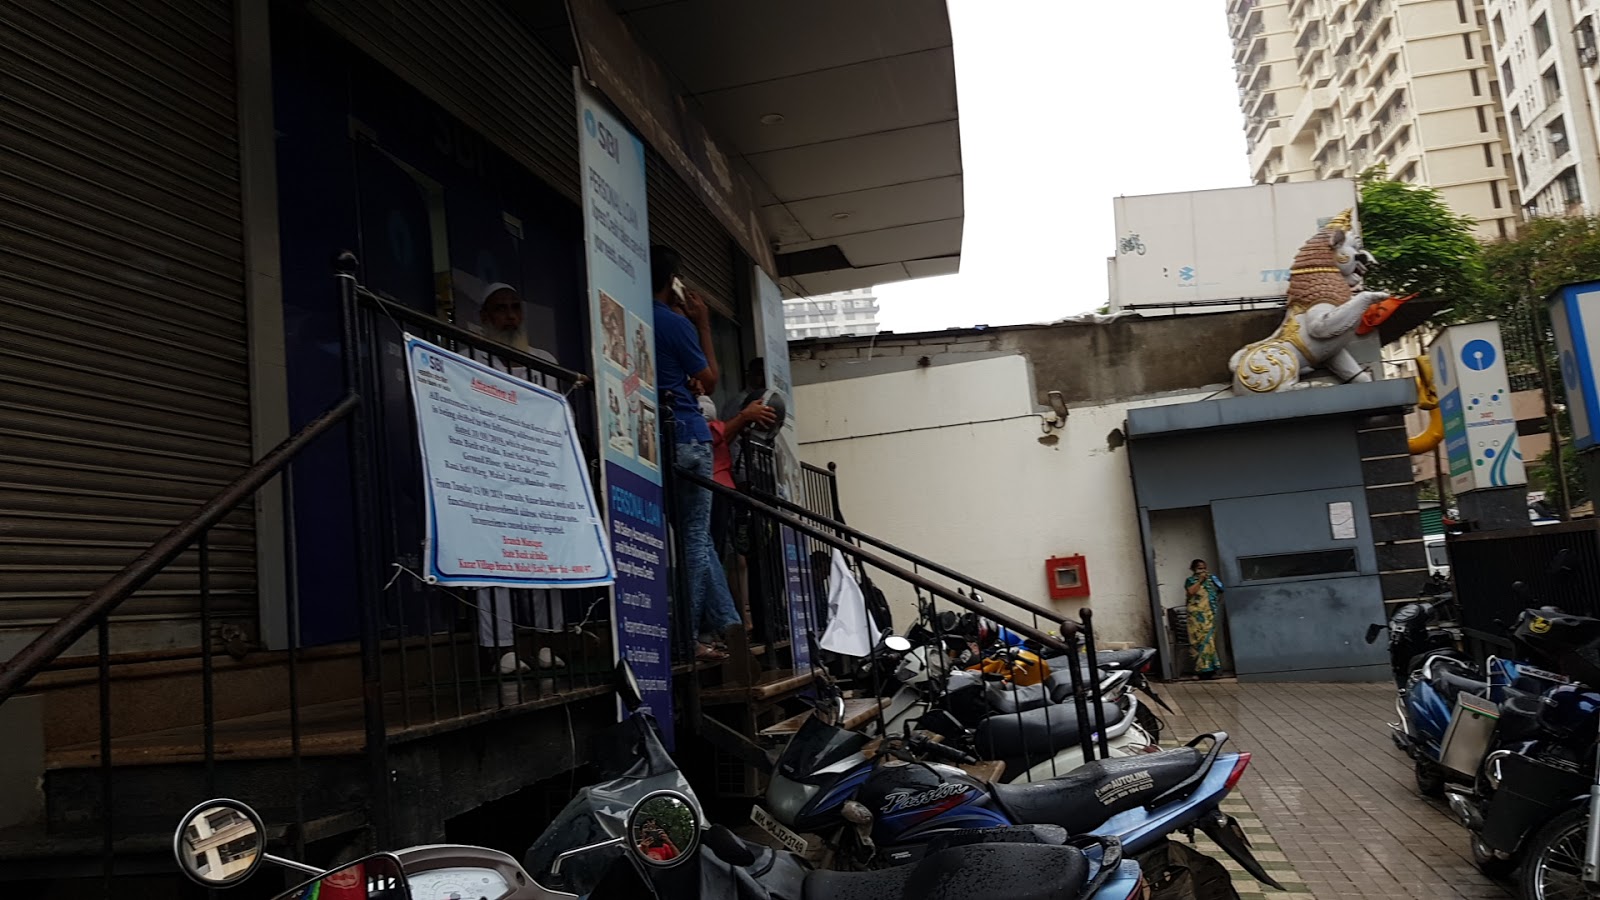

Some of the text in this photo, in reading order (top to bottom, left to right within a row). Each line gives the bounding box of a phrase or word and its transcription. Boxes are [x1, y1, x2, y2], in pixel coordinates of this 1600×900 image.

[597, 121, 620, 164] SBI
[429, 355, 445, 374] SBI
[611, 484, 645, 521] PERSONAL
[1111, 770, 1152, 789] AUTOLINK
[880, 782, 969, 814] Passion
